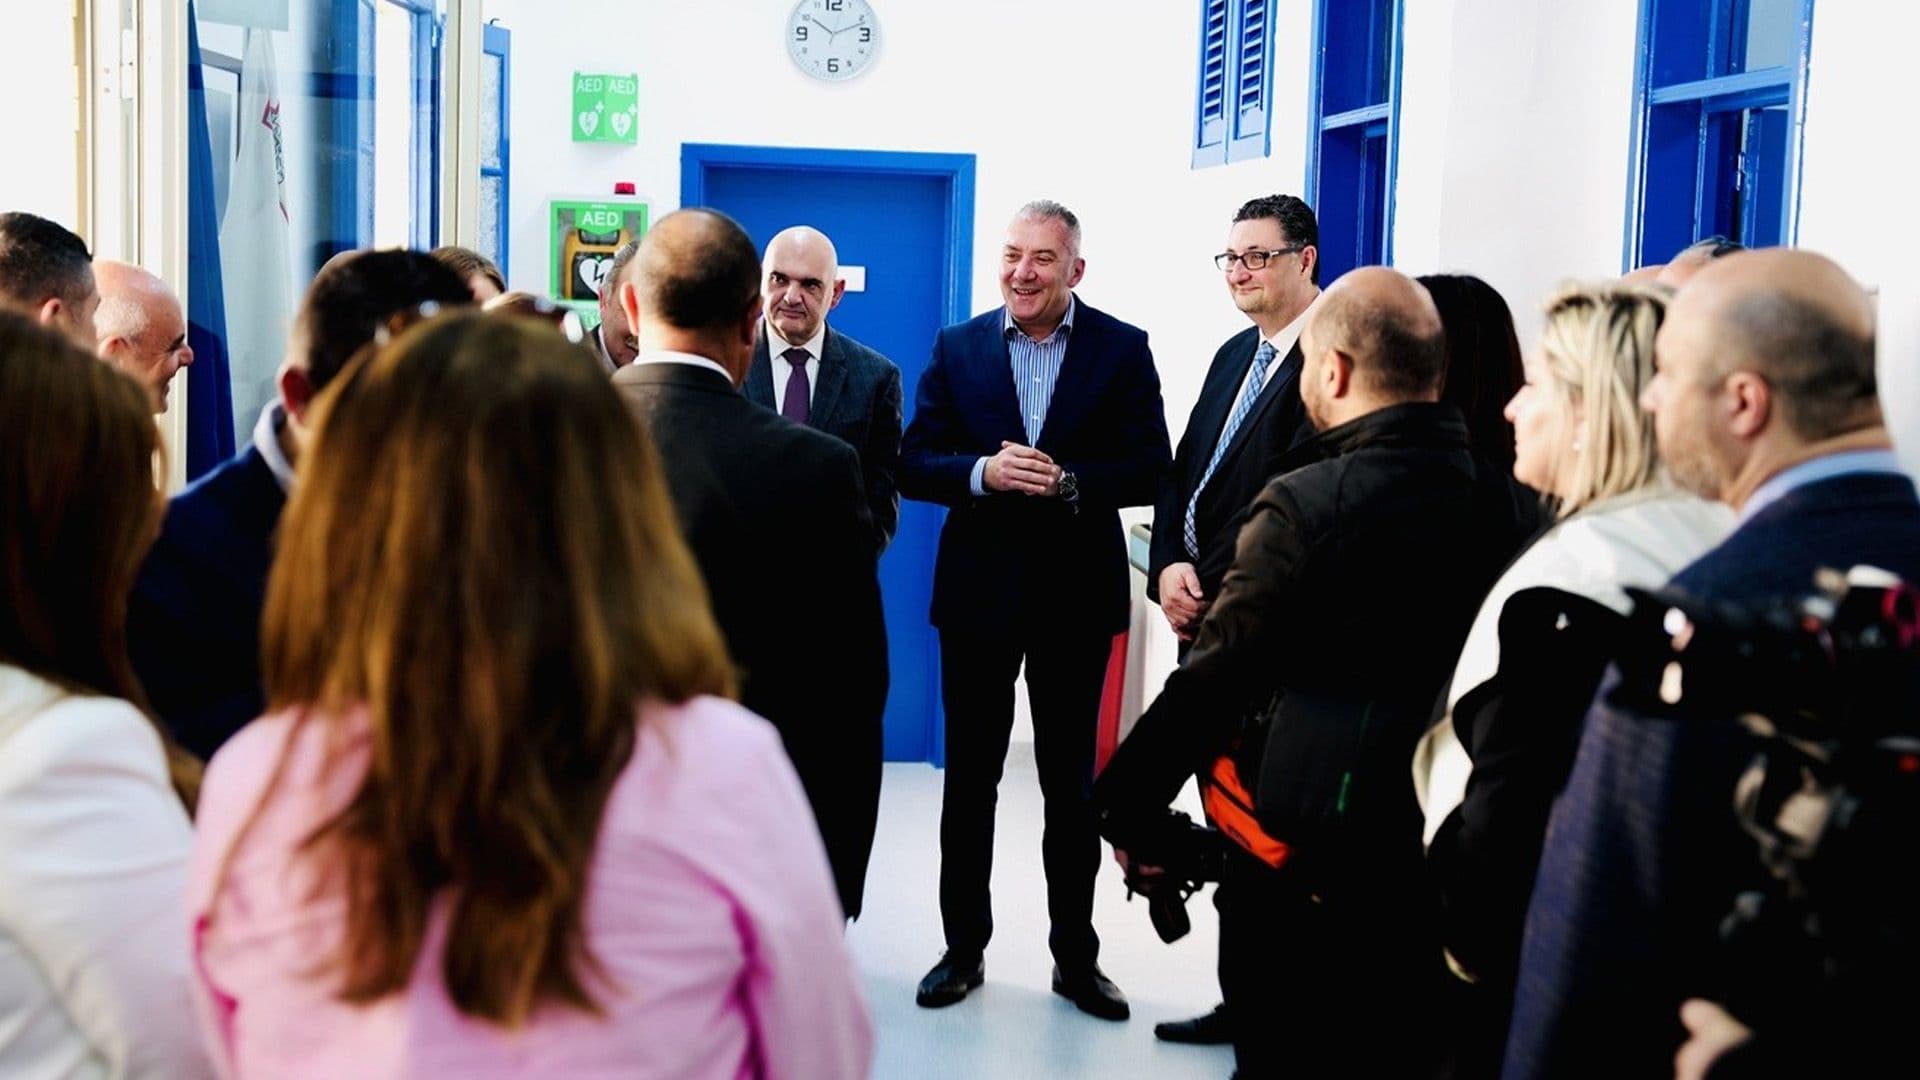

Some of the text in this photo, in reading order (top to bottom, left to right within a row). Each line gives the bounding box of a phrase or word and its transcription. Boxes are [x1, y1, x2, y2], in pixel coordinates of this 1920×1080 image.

[826, 0, 843, 11] 12
[796, 26, 808, 41] 9
[859, 27, 870, 42] 3
[827, 58, 839, 73] 6
[576, 78, 603, 93] AED
[608, 79, 636, 95] AED
[582, 210, 619, 226] AED
